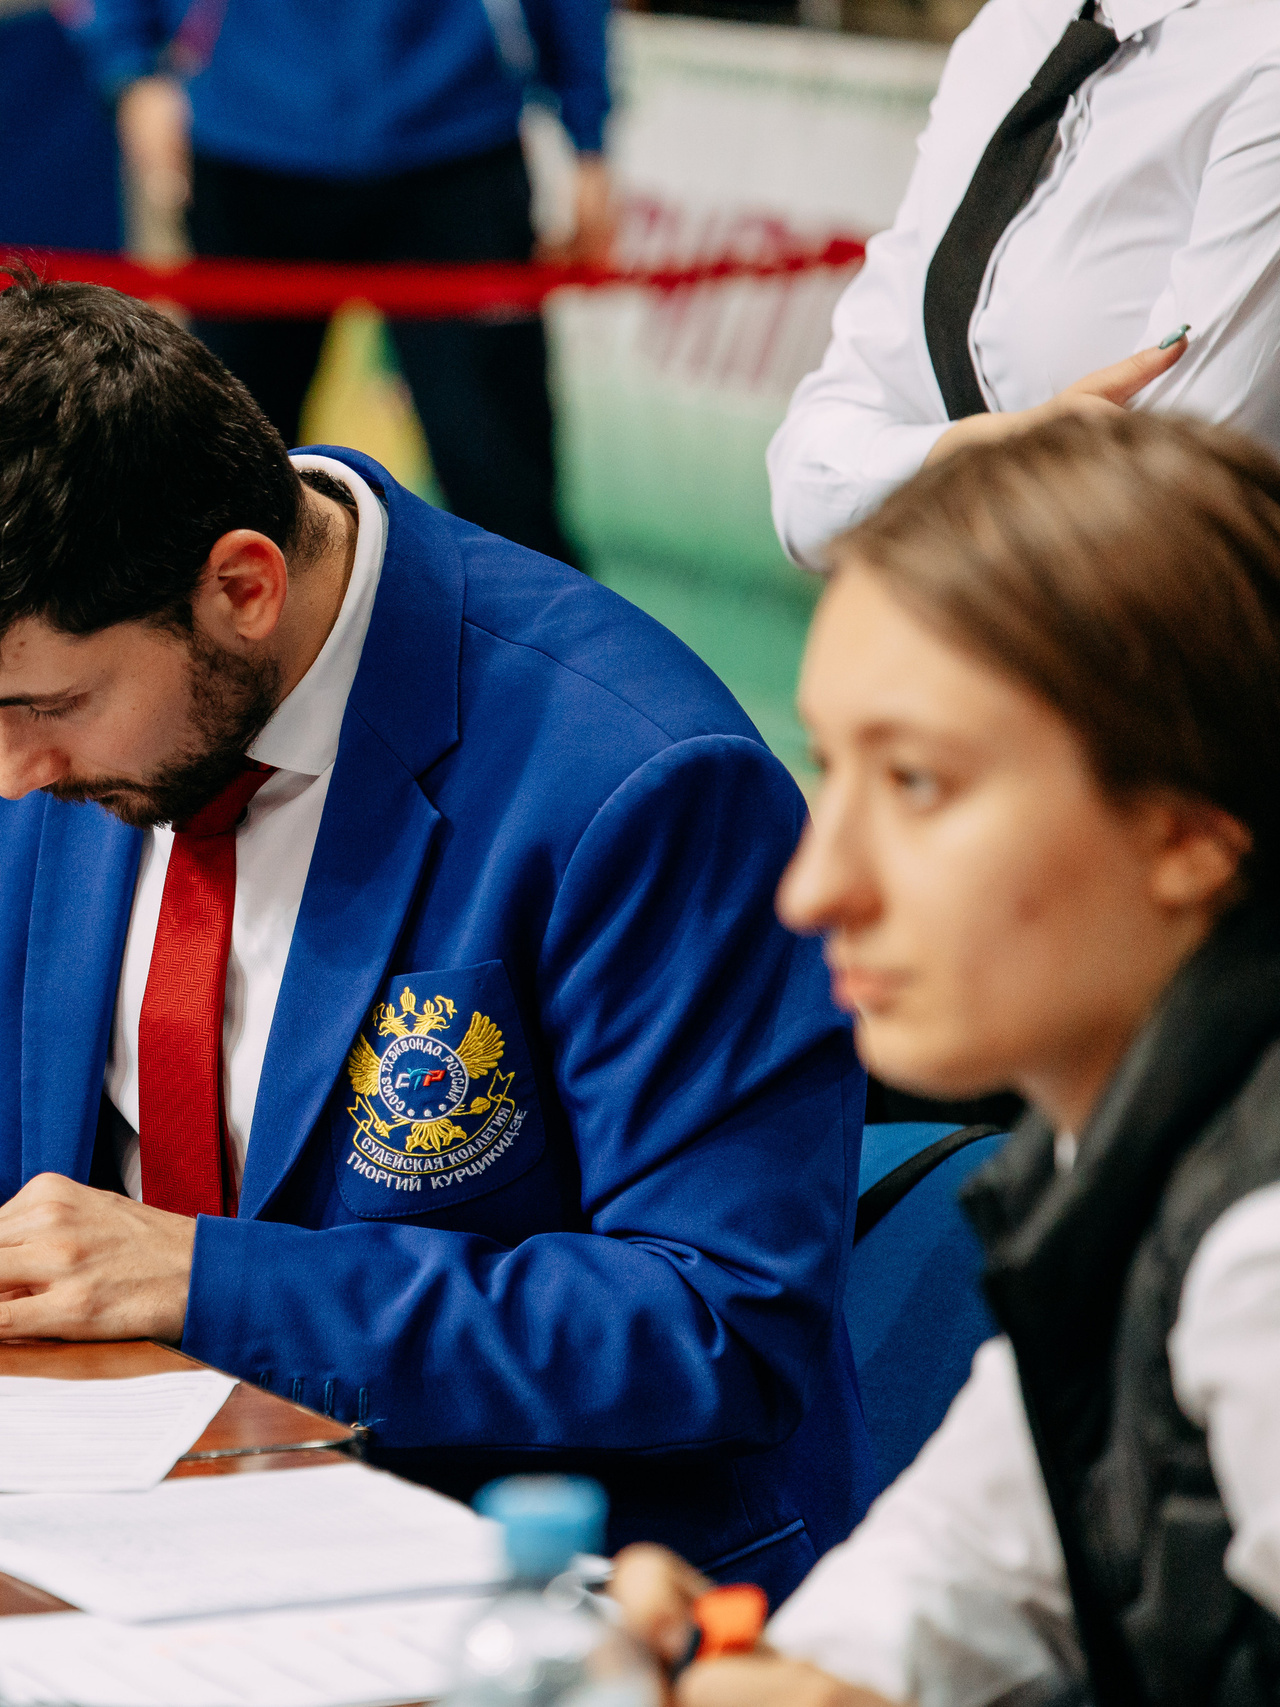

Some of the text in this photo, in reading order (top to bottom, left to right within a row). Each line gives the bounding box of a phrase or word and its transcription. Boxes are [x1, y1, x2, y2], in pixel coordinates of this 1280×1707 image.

[381, 1037, 465, 1111] СОЮЗ ТХЭКВОНДО РОССИИ
[346, 1108, 528, 1191] ГИОРГИЙ КУРЦИКИДЗЕ
[360, 1106, 511, 1171] СУДЕЙСКАЯ КОЛЛЕГИЯ
